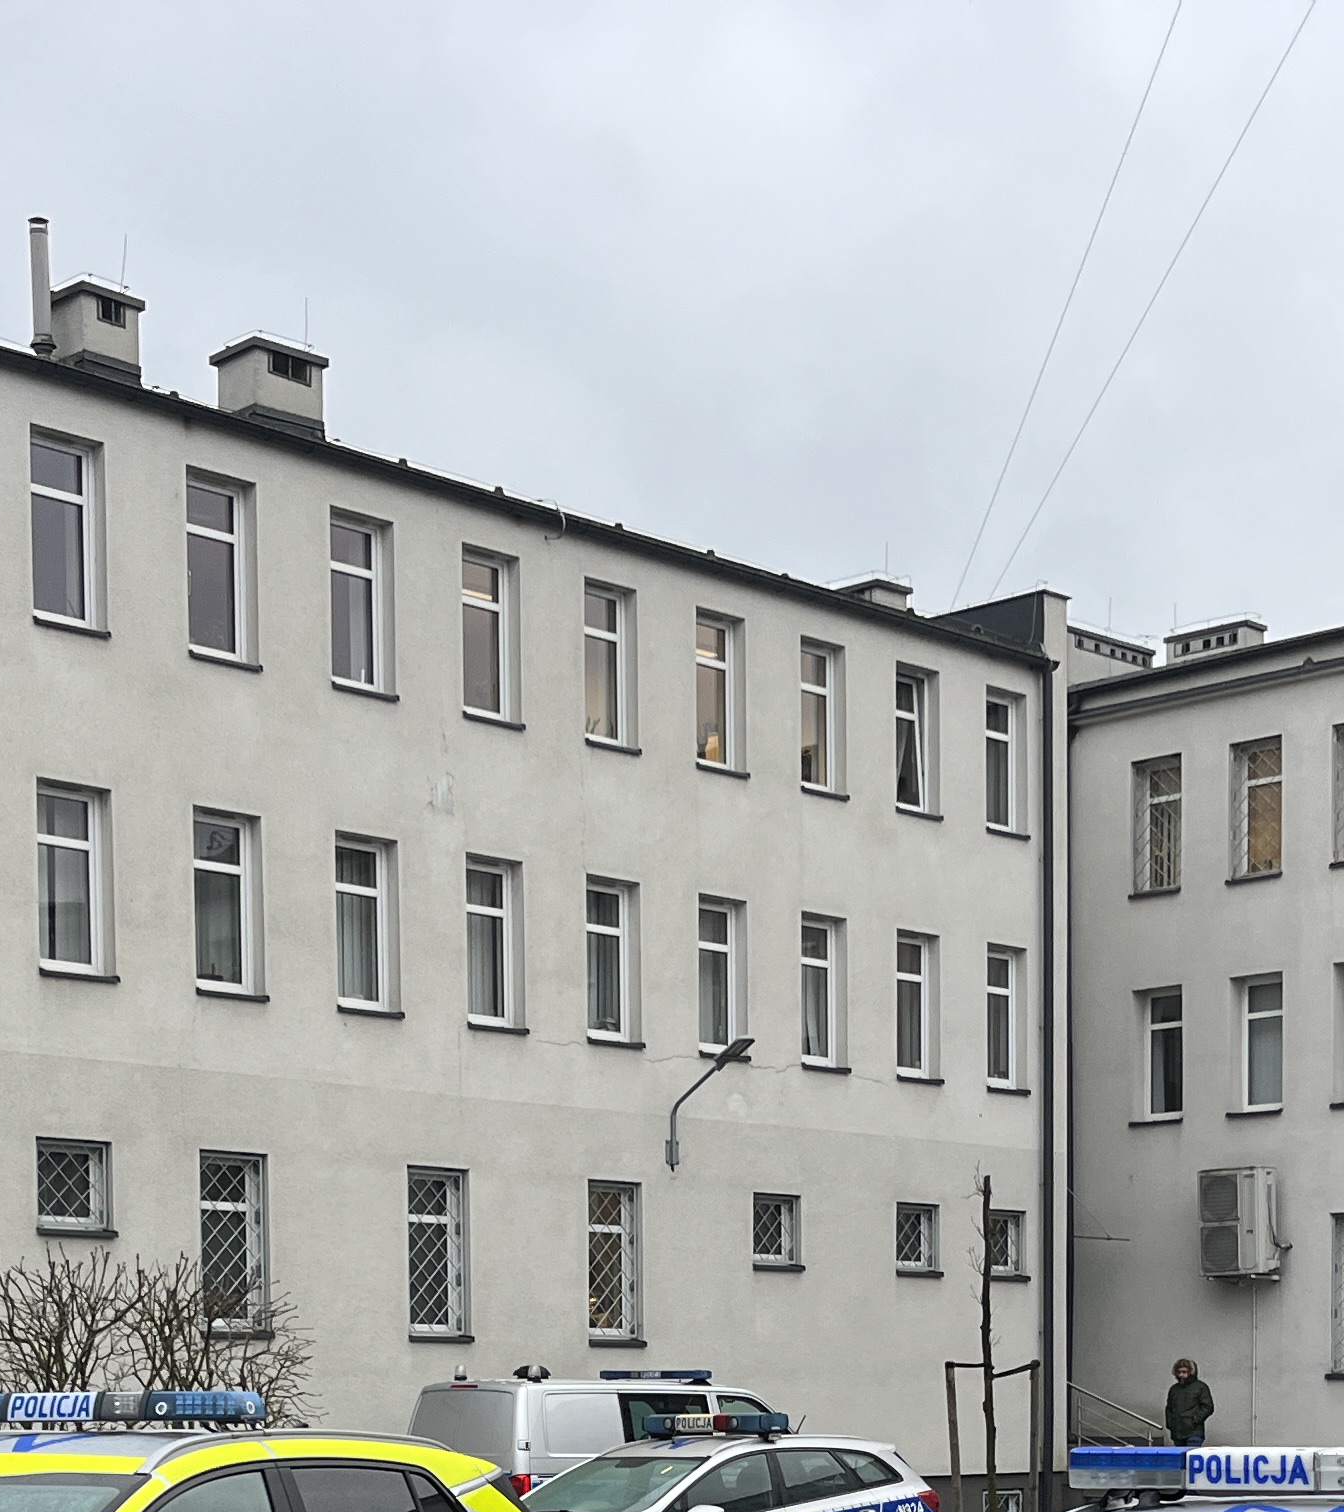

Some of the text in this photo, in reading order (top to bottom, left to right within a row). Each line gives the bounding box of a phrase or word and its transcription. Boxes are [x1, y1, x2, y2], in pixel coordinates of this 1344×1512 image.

[10, 1394, 91, 1419] POLICJA
[676, 1416, 713, 1429] POLICJA
[1188, 1454, 1310, 1486] POLICJA
